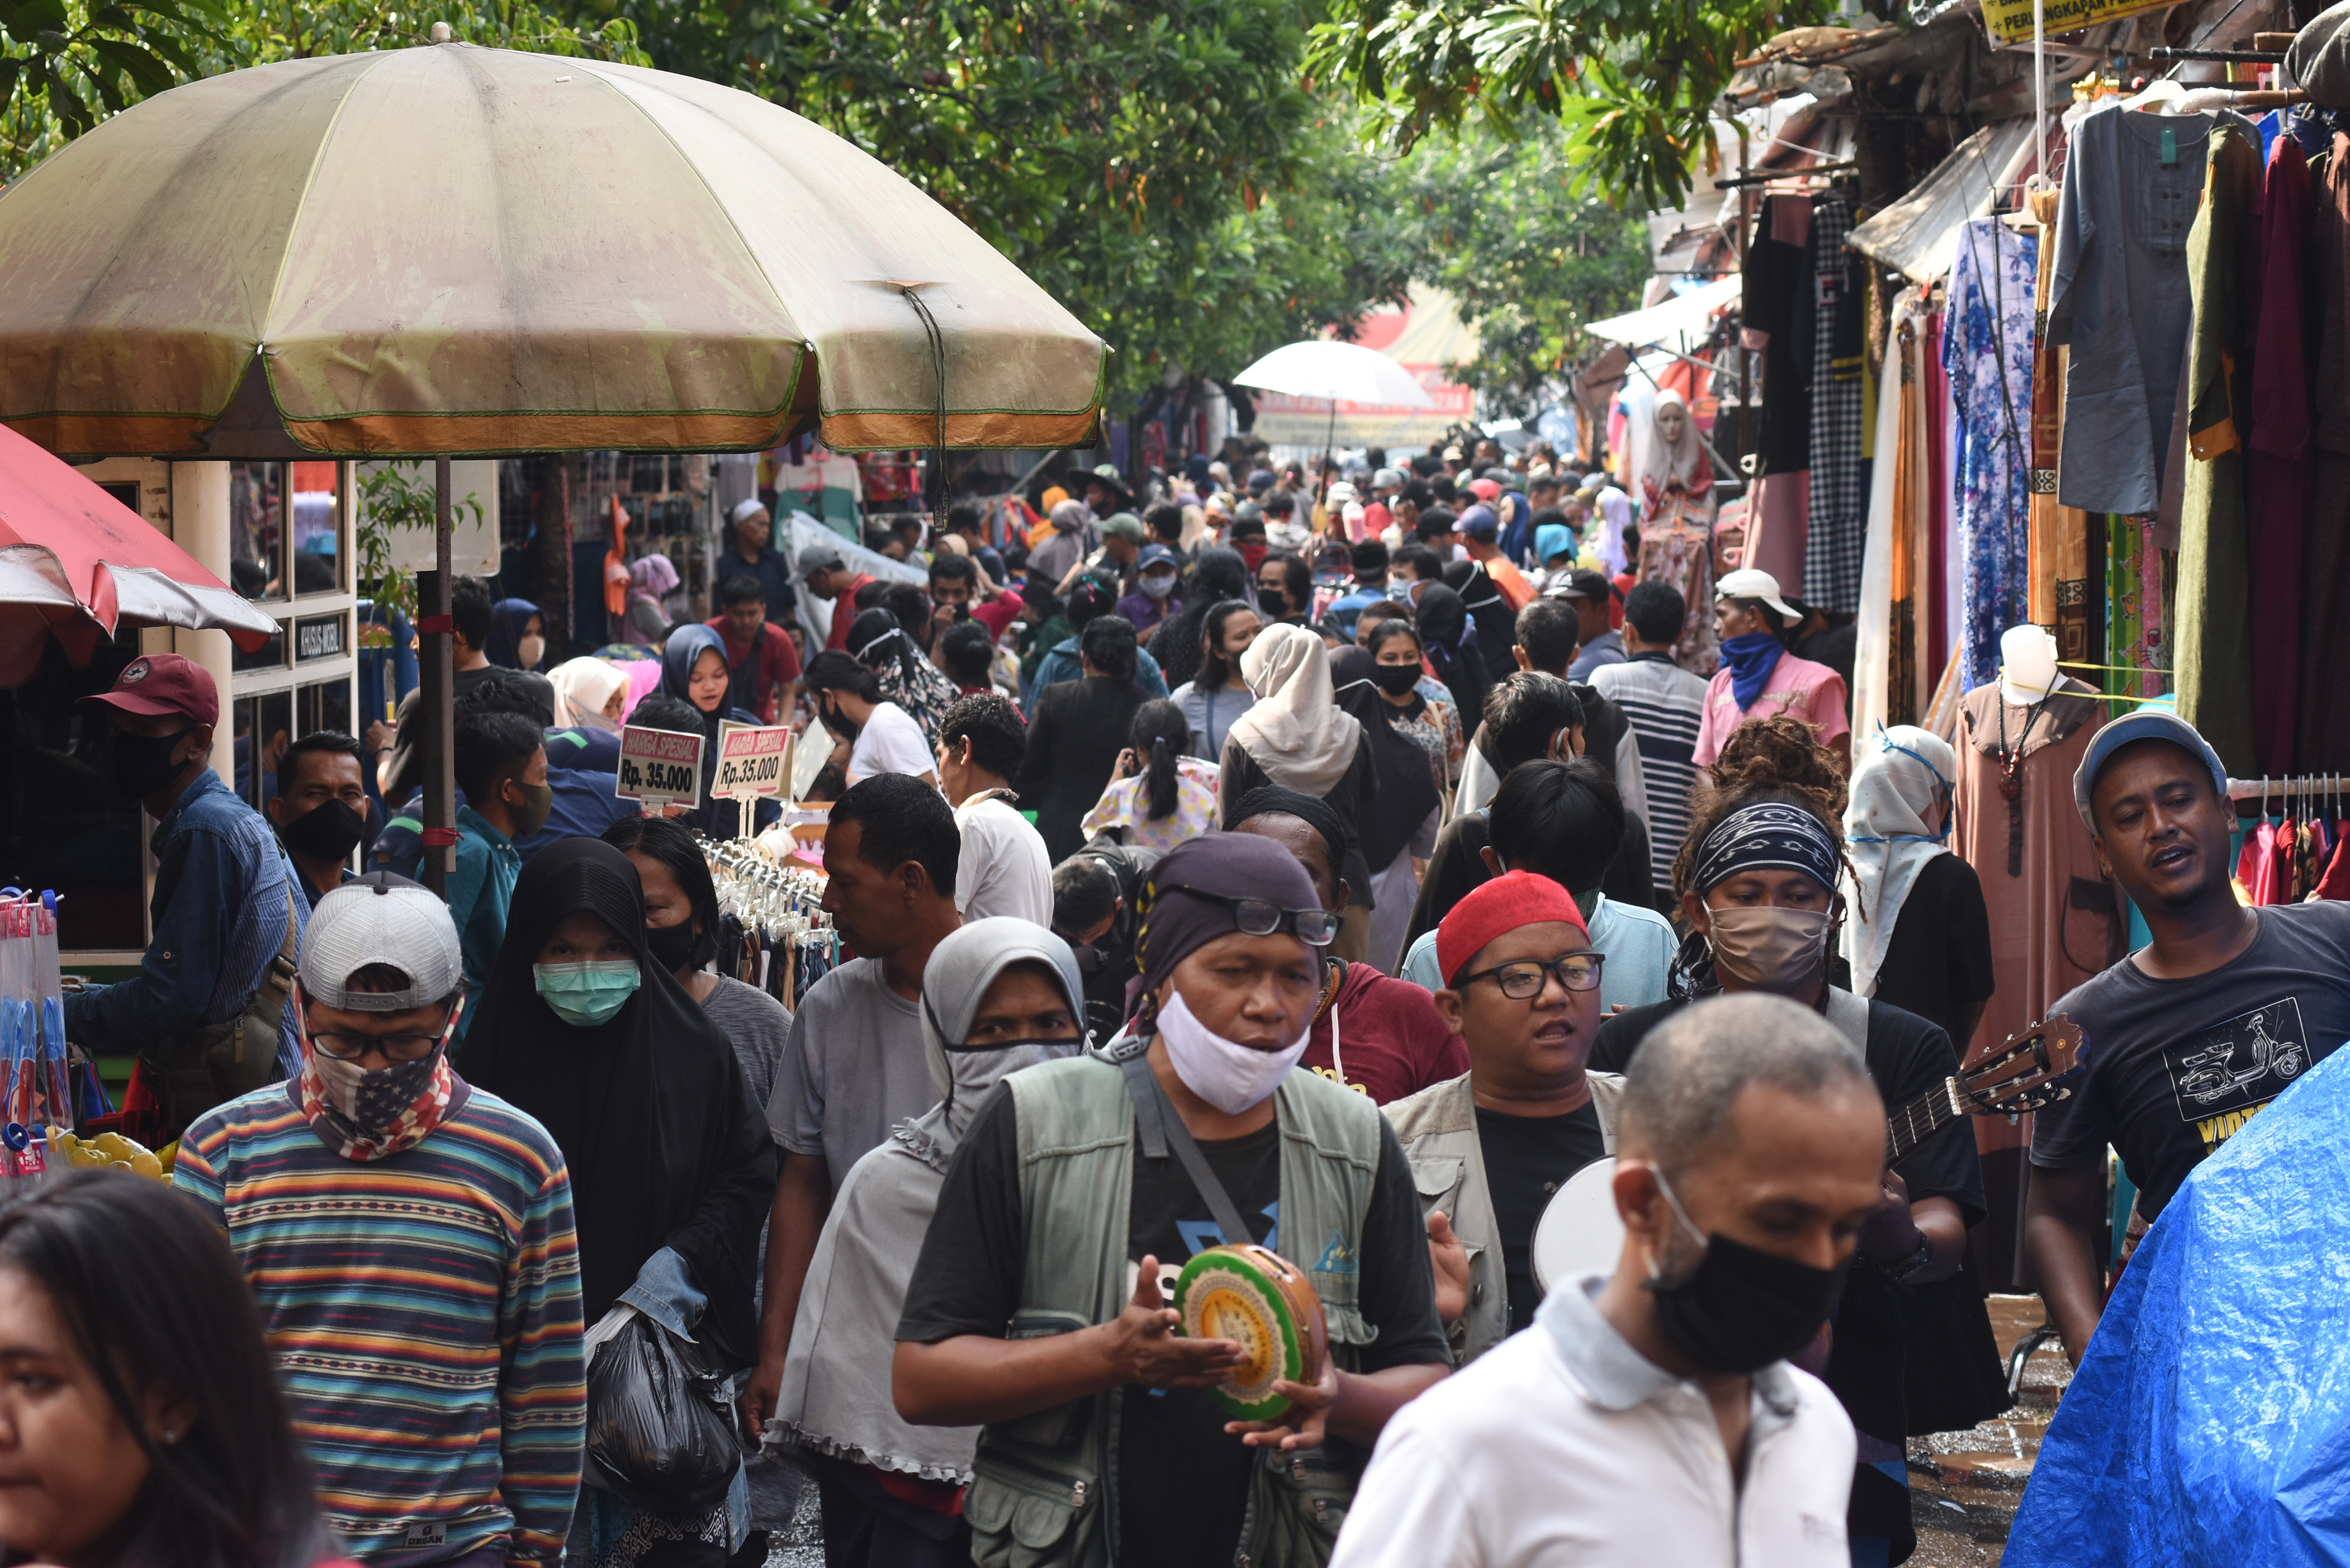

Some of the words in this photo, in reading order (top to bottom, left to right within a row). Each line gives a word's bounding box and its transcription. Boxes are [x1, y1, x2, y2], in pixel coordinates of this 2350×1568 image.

[2004, 0, 2106, 31] PERLNGKAPAN
[301, 626, 321, 656] KHUSUS
[323, 623, 339, 654] MOBIL
[625, 731, 657, 754] HARGA
[658, 737, 695, 760] SPESIAL
[727, 735, 755, 755] HARGA
[754, 732, 784, 753] SPESIAL
[621, 759, 642, 791] Rp.
[646, 762, 692, 793] 35.000
